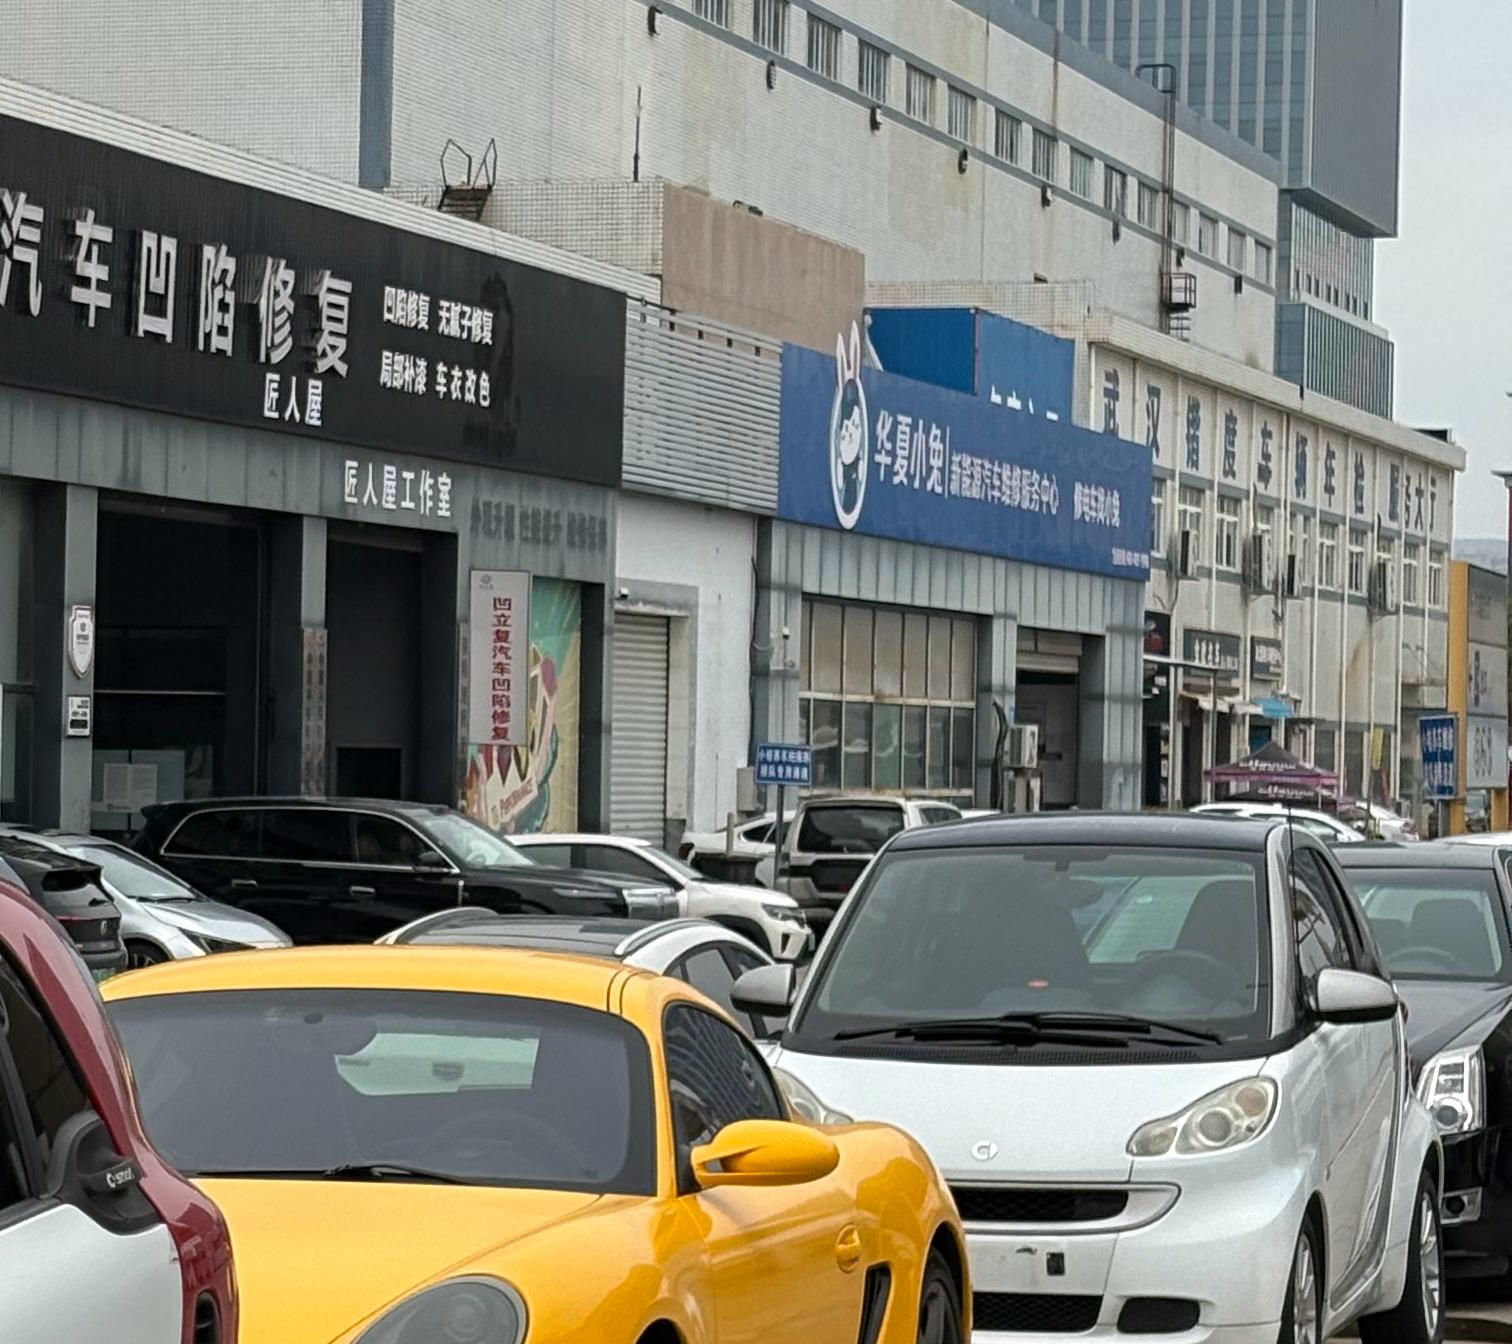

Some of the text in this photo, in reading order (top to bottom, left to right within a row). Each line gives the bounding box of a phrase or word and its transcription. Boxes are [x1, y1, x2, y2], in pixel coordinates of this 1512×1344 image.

[383, 285, 493, 346] 凹陷修复 无腻子修复
[263, 372, 323, 426] 匠人屋
[380, 350, 491, 407] 局部补漆 车衣改色
[873, 410, 944, 495] 华夏小兔
[345, 460, 452, 517] 匠人屋工作室
[491, 597, 512, 742] 凹立复汽车凹陷修复
